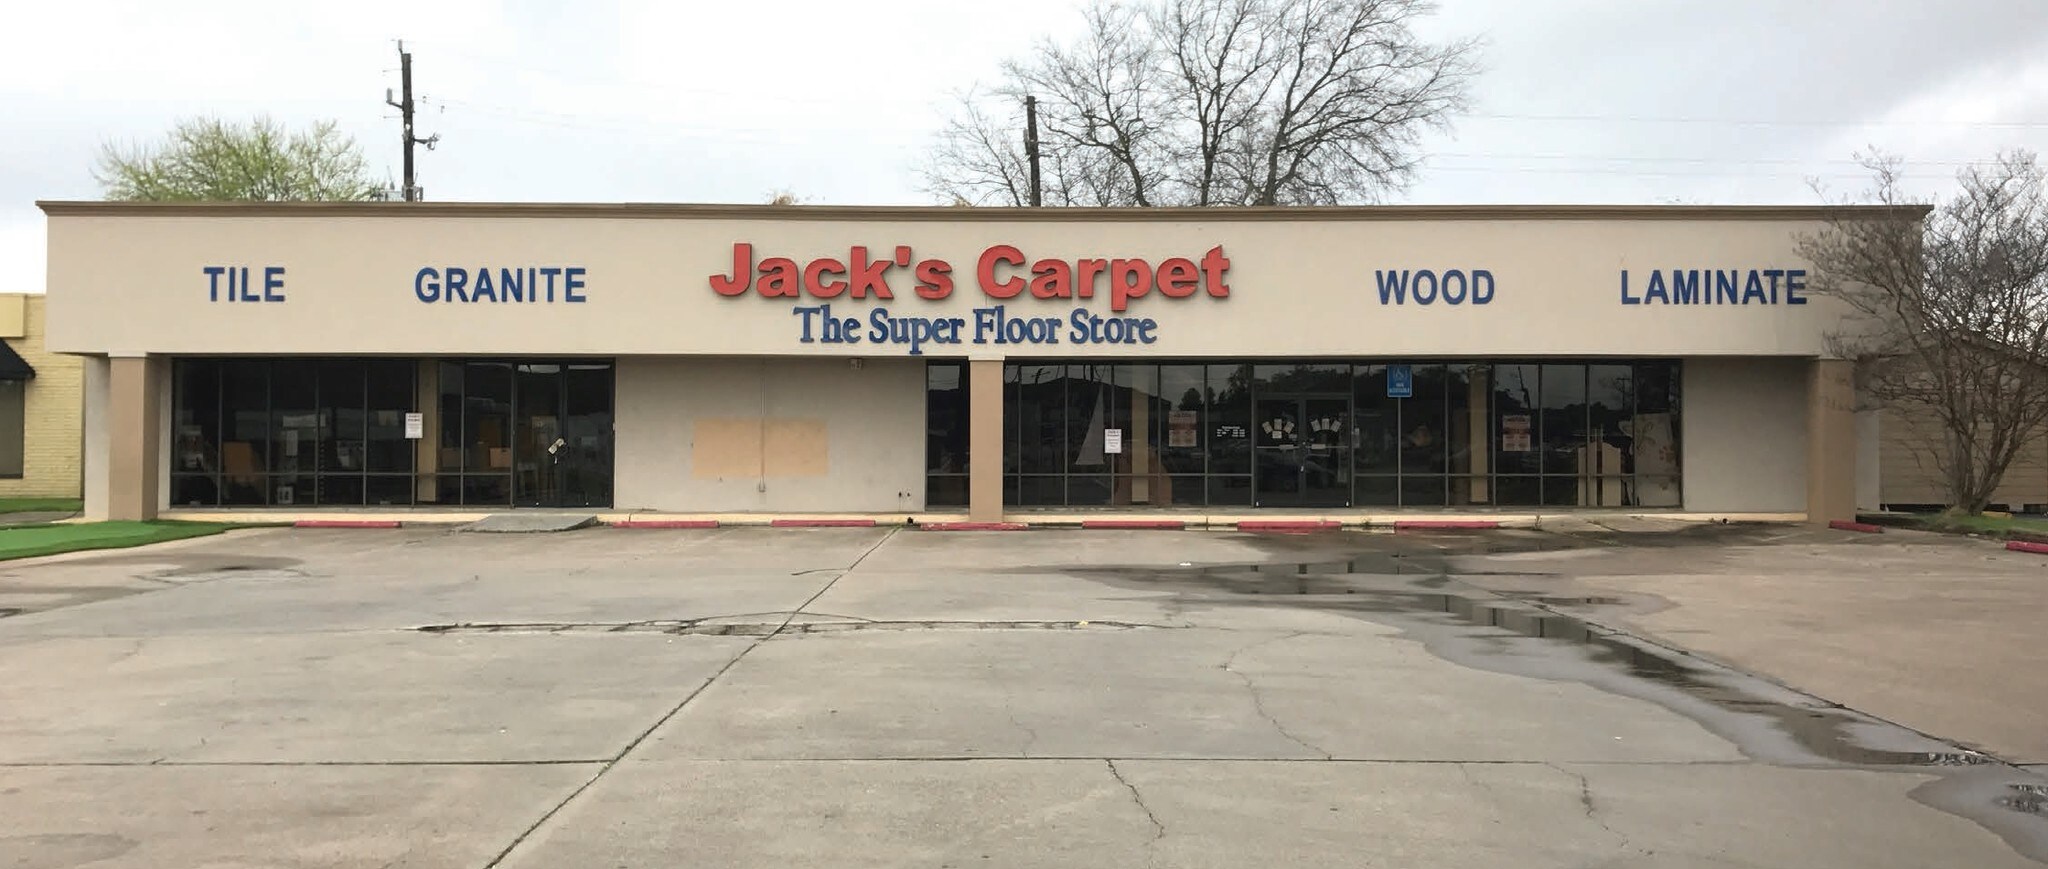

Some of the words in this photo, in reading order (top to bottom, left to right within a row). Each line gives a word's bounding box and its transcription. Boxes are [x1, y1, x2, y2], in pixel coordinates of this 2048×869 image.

[203, 266, 285, 303] TILE
[414, 267, 587, 304] GRANITE
[709, 242, 954, 299] Jack's
[976, 244, 1231, 311] Carpet
[1375, 269, 1496, 305] WOOD
[1620, 269, 1808, 305] LAMINATE
[793, 304, 862, 344] The
[868, 307, 965, 355] Super
[973, 305, 1063, 345] Floor
[1069, 307, 1158, 345] Store
